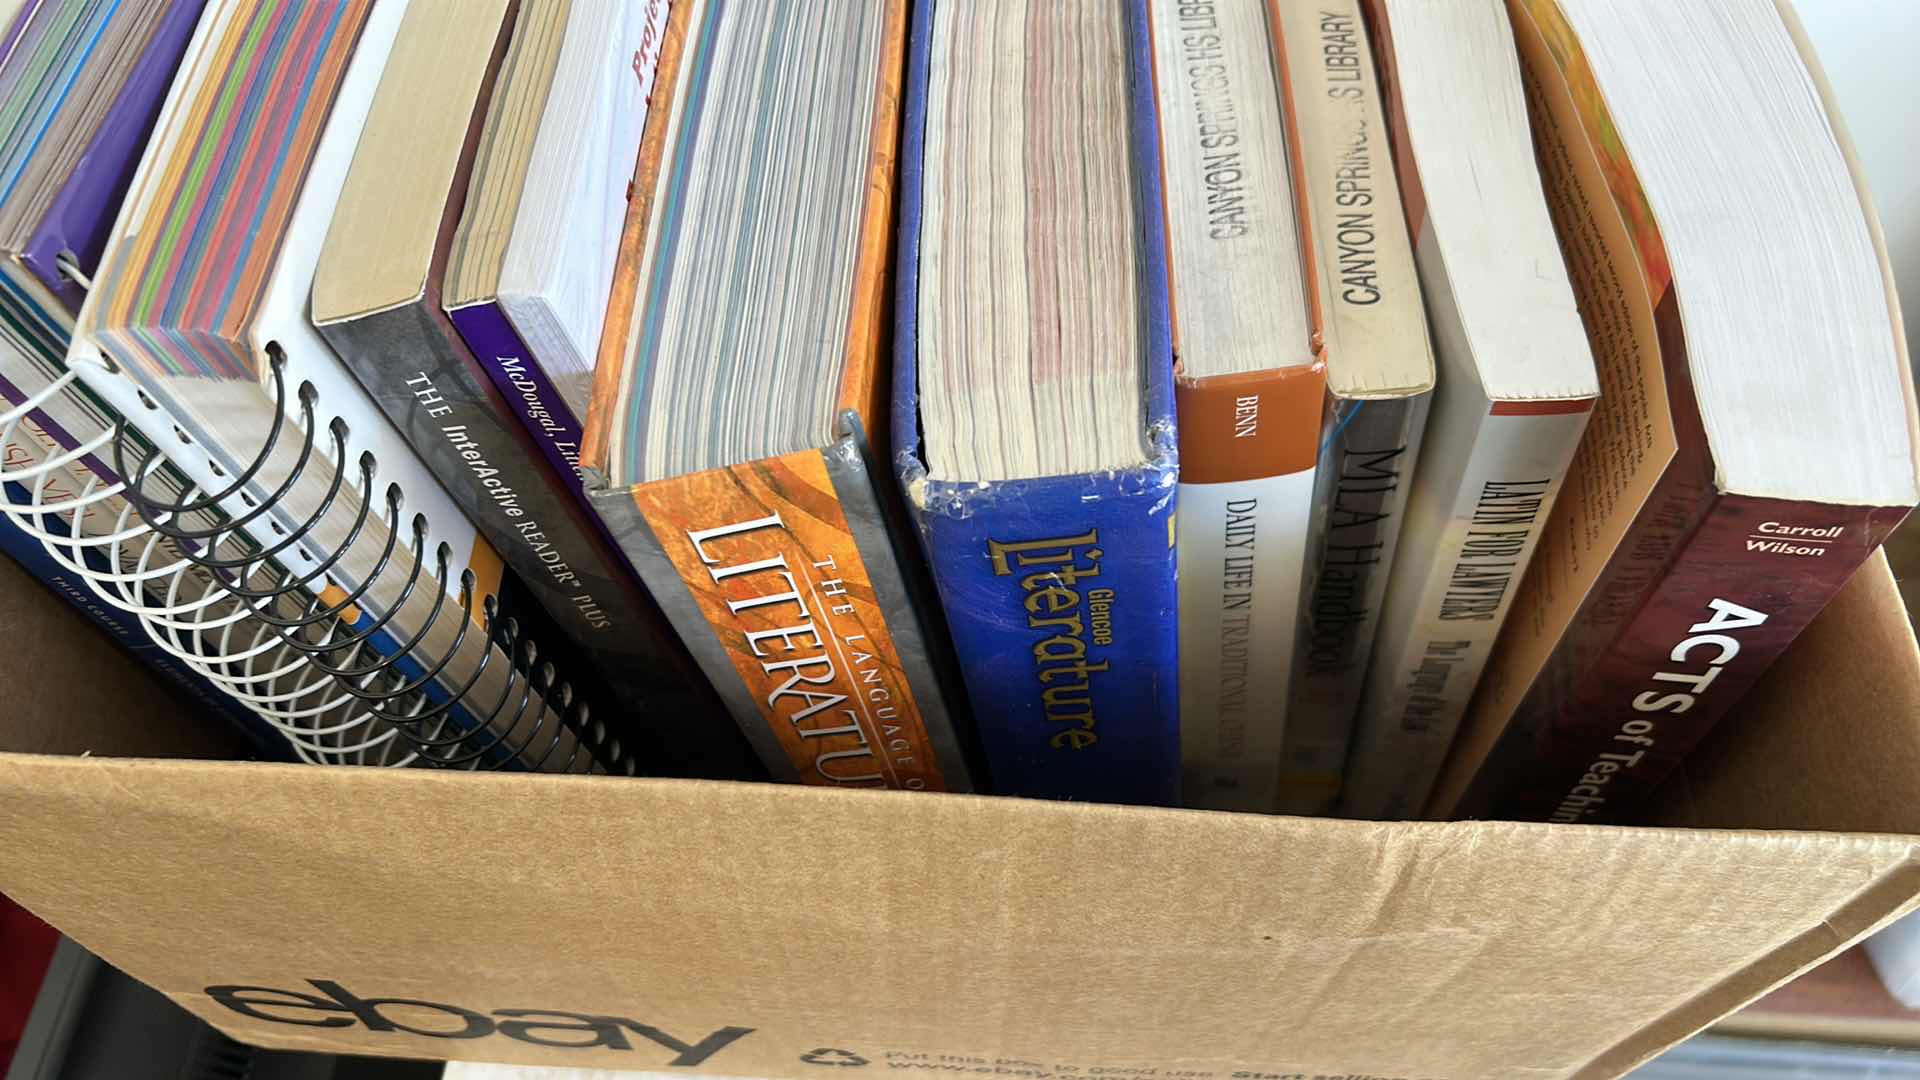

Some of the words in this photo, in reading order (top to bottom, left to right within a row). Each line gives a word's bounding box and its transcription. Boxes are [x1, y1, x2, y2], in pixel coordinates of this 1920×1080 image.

[632, 0, 662, 87] Proje
[1183, 35, 1223, 61] HS
[1320, 11, 1361, 82] LIBRARY
[1203, 151, 1249, 241] CANYON
[1337, 213, 1382, 306] CANYON
[496, 354, 567, 438] McDougal,
[1234, 394, 1259, 438] BENN
[405, 372, 454, 419] THE
[441, 424, 524, 518] InterActive
[571, 594, 611, 631] PLUS
[1332, 446, 1407, 530] MLA
[1472, 478, 1551, 525] LATIN
[1225, 497, 1257, 549] DAILY
[1459, 529, 1530, 559] FOR
[1746, 540, 1826, 557] Wilson
[1757, 521, 1845, 539] Carroll
[1222, 592, 1254, 610] IN
[1224, 555, 1255, 588] LIFE
[1438, 561, 1517, 621] LAWYERS
[987, 527, 1111, 750] Literature
[1088, 588, 1115, 645] Glencoe
[686, 510, 888, 789] LITERATU
[812, 554, 855, 616] THE
[845, 633, 913, 763] LANGUAGE
[1218, 615, 1252, 715] TRADITIONAL
[1632, 597, 1769, 714] ACTS
[1614, 719, 1655, 747] of
[203, 978, 756, 1067] ebay
[885, 1051, 929, 1060] Put
[939, 1054, 986, 1064] this
[1054, 1063, 1081, 1073] to
